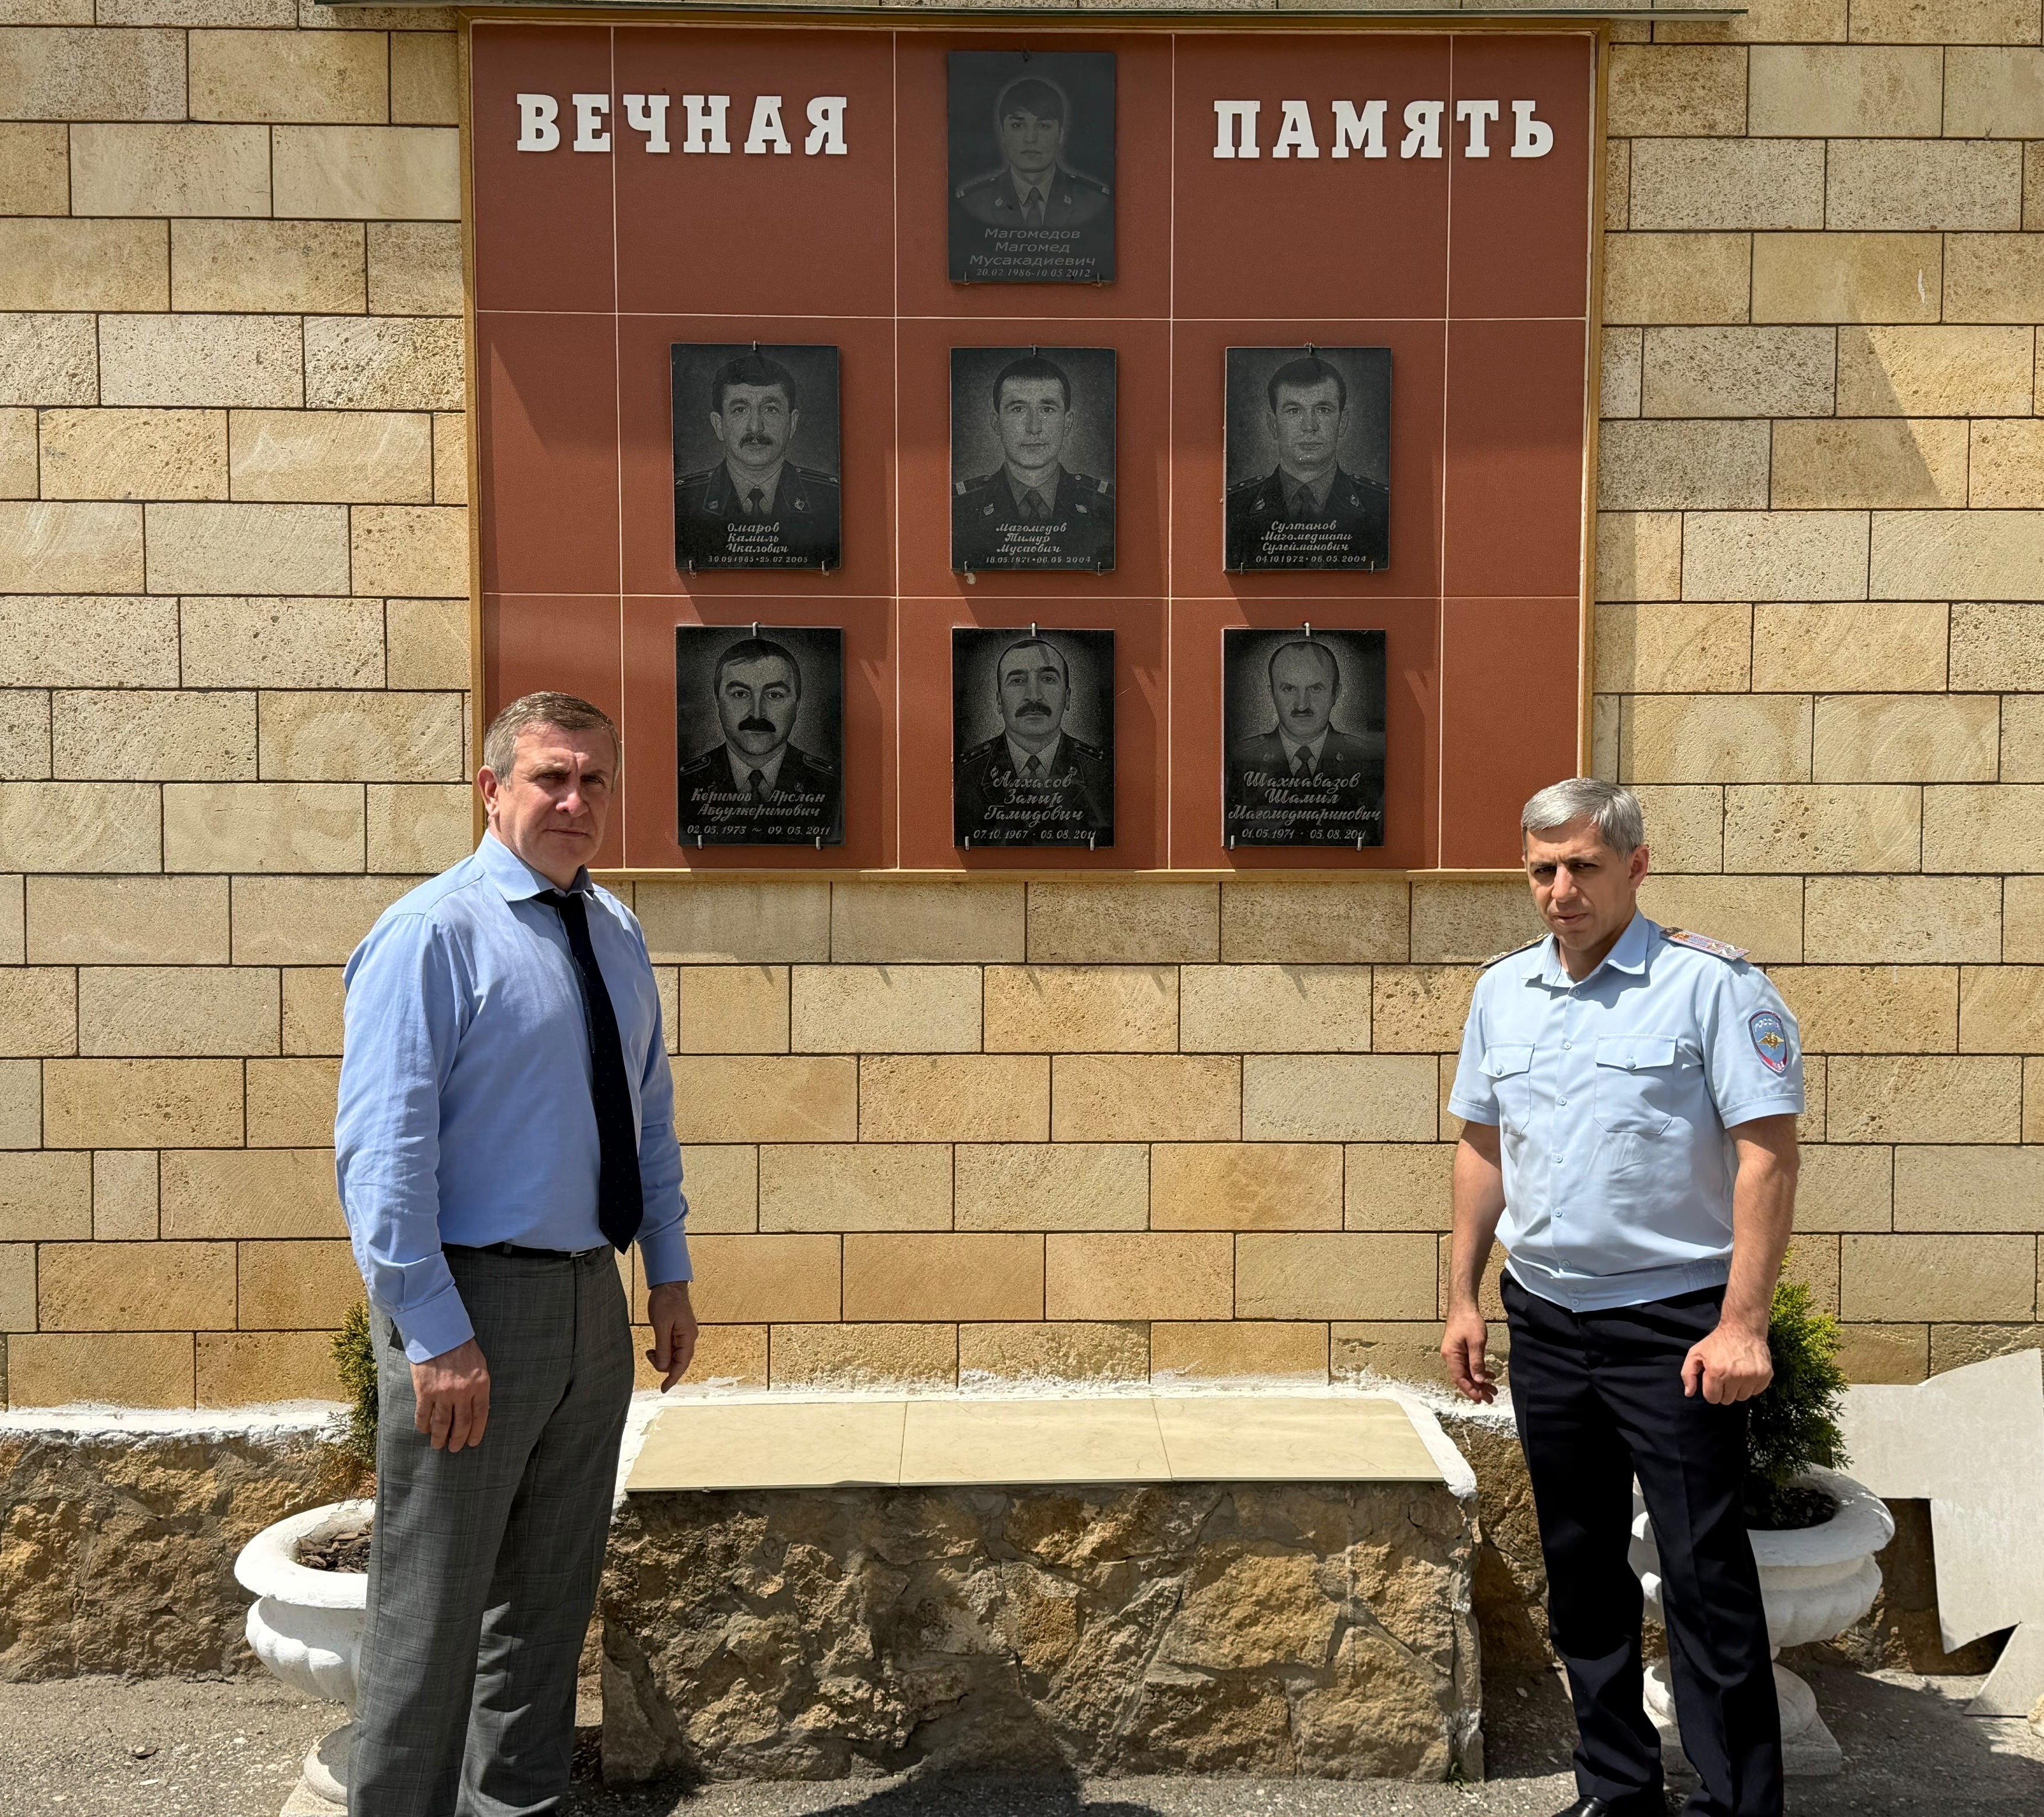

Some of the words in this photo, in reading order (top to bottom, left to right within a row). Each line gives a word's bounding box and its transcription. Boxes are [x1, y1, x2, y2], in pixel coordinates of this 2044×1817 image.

[517, 94, 848, 155] ВЕЧНАЯ
[1213, 100, 1554, 159] ПАМЯТЬ
[984, 228, 1081, 239] Магомедов
[995, 242, 1070, 253] Магомед
[970, 255, 1095, 267] Мусакадиевич
[727, 522, 780, 535] Омаров
[995, 522, 1067, 535] Магомедов
[1271, 519, 1337, 533] Султанов
[727, 533, 779, 542] Камиль
[1005, 533, 1050, 545] Тимур
[726, 543, 790, 553] Чкалович
[996, 543, 1062, 555] Мусаевич
[1262, 542, 1350, 554] Сулейманович
[992, 770, 1073, 789] Алхасов
[1243, 770, 1362, 794] Шахнавазов
[691, 788, 752, 804] Керимов
[768, 790, 826, 806] Арслан
[697, 804, 821, 822] Абдулкеримович
[984, 805, 1085, 828] Гамидович
